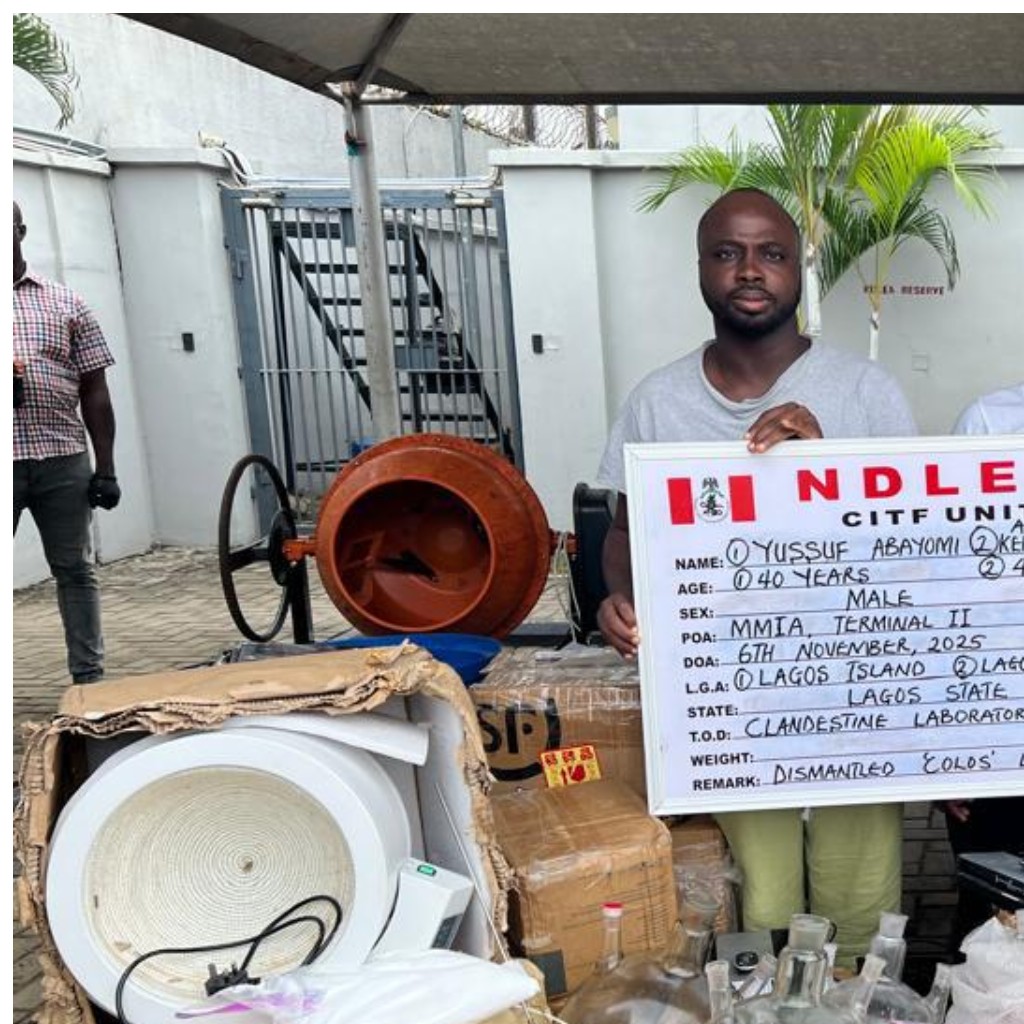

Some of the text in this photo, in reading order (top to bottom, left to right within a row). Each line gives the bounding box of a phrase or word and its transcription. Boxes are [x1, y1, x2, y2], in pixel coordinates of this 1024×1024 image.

[842, 508, 929, 527] CITF
[752, 539, 849, 564] YUSSUF
[872, 536, 960, 560] ABAYOMI
[675, 557, 723, 570] NAME:
[758, 569, 784, 589] 40
[793, 567, 870, 588] YEARS
[678, 582, 713, 595] AGE:
[846, 588, 914, 610] MALE
[680, 609, 714, 619] SEX:
[834, 615, 934, 635] TERMINAL
[949, 608, 972, 628] II
[682, 633, 716, 644] POA:
[738, 634, 986, 664] 6TH NOVEMBER, 2025
[684, 657, 719, 668] DOA:
[759, 665, 829, 686] LAGOS
[845, 660, 925, 683] ISLAND
[686, 683, 729, 694] L.G.A:
[848, 681, 1008, 707] LAGOS STATE
[687, 706, 738, 718] STATE:
[745, 713, 888, 738] CLANDESTINE
[689, 731, 731, 742] T.O.D:
[690, 752, 754, 766] WEIGHT:
[773, 762, 895, 785] DISMANTLED
[693, 776, 760, 791] REMARK:
